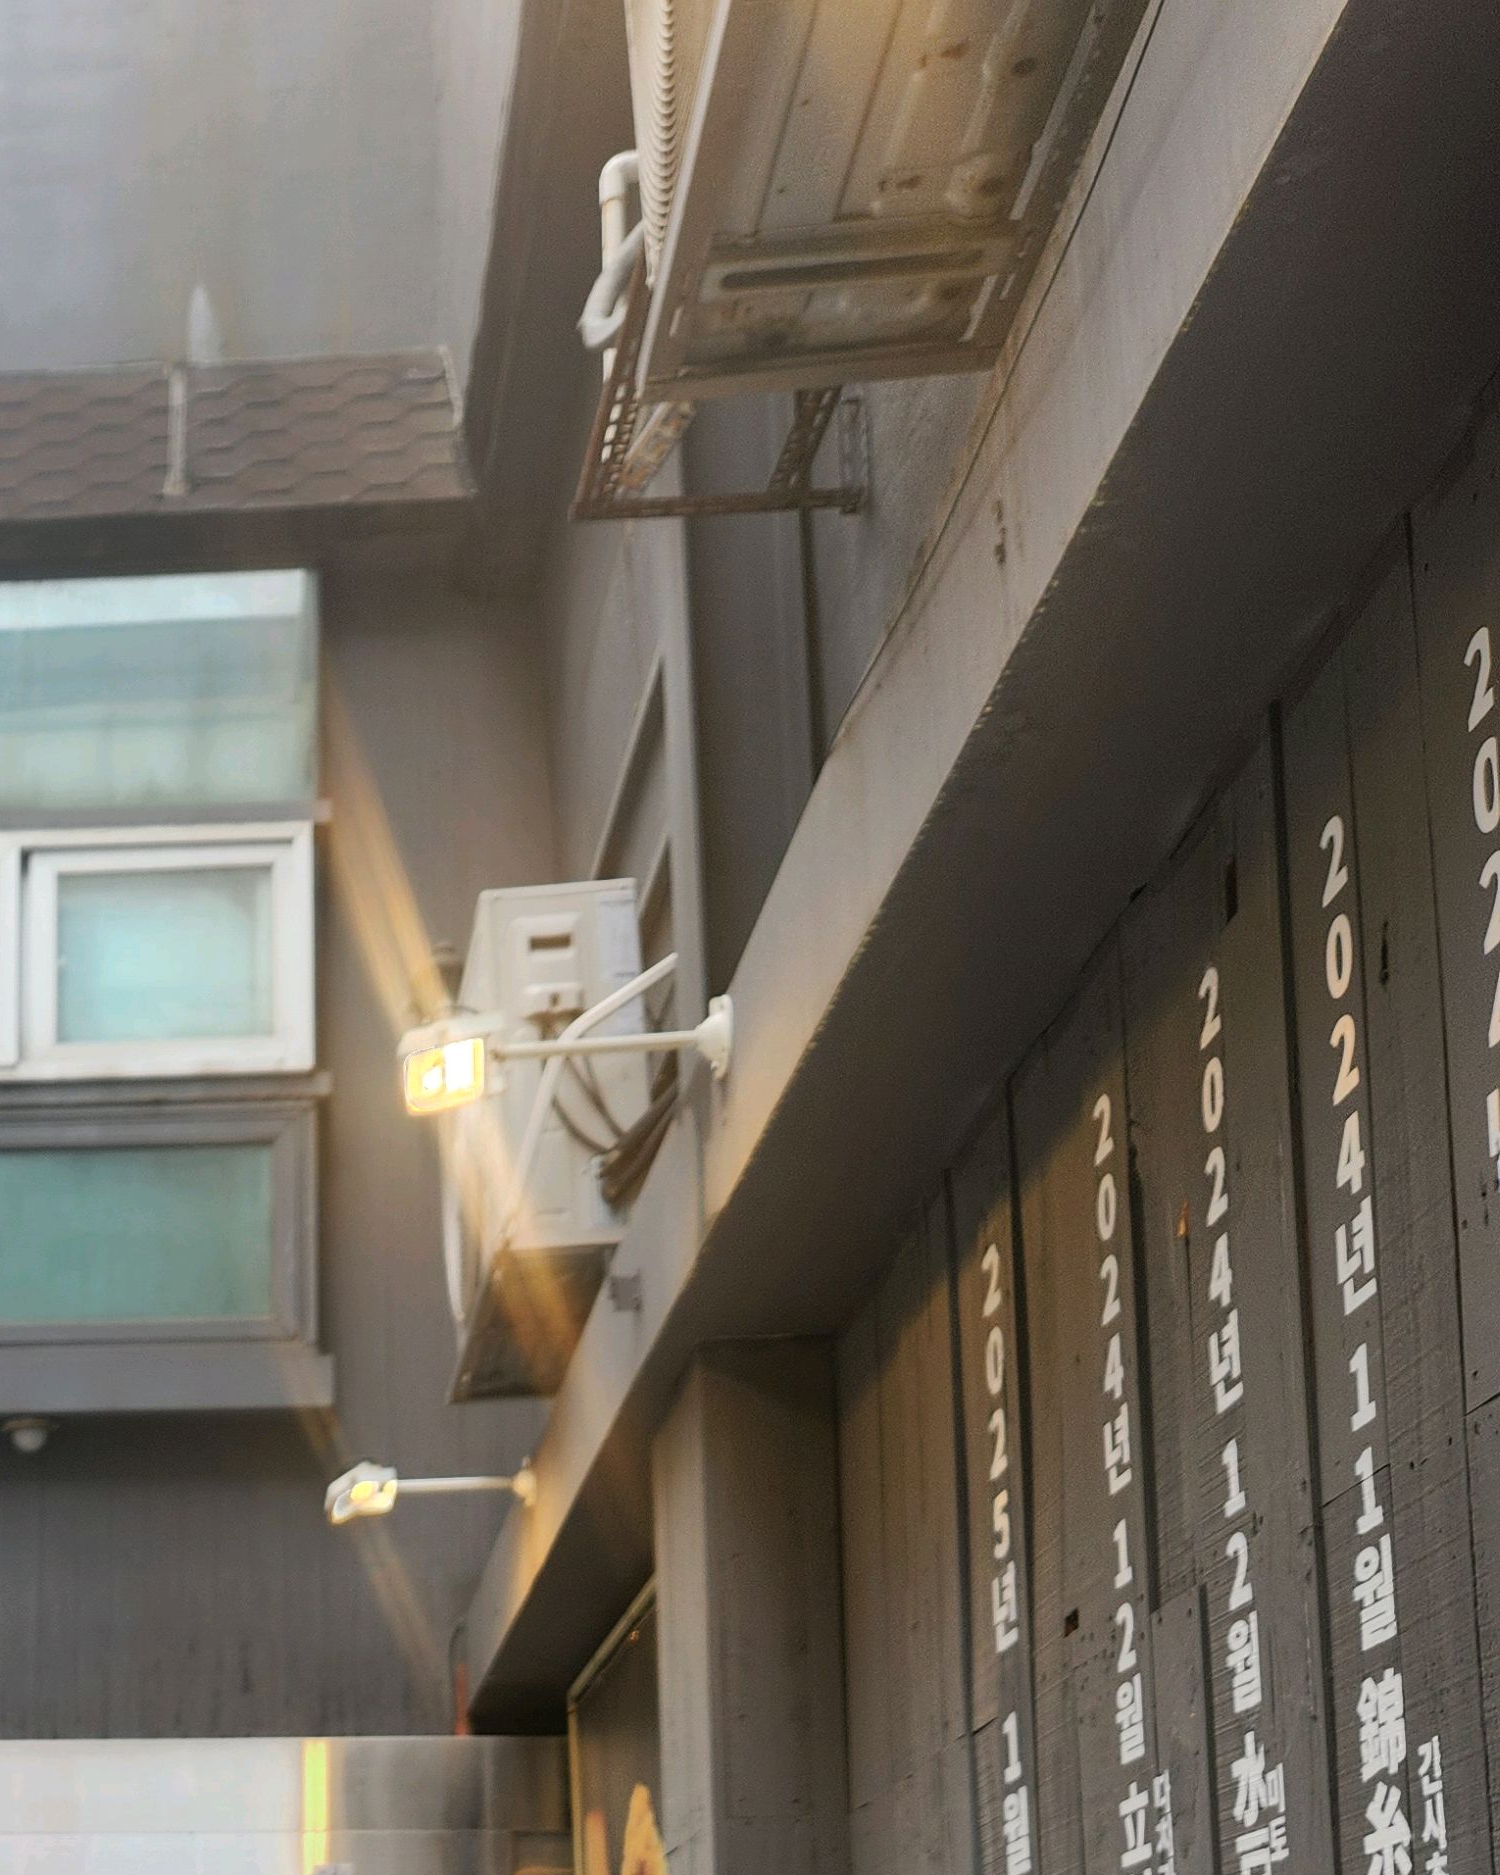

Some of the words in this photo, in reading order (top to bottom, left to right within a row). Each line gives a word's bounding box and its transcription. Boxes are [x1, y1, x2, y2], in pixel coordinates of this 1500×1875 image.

[1093, 1092, 1132, 1495] 2024년
[1199, 966, 1244, 1414] 2024년
[1319, 815, 1378, 1317] 2024년
[1350, 1342, 1398, 1651] 11월
[981, 1243, 1020, 1653] 2025년
[1112, 1518, 1146, 1765] 12월
[1221, 1438, 1263, 1714] 12월
